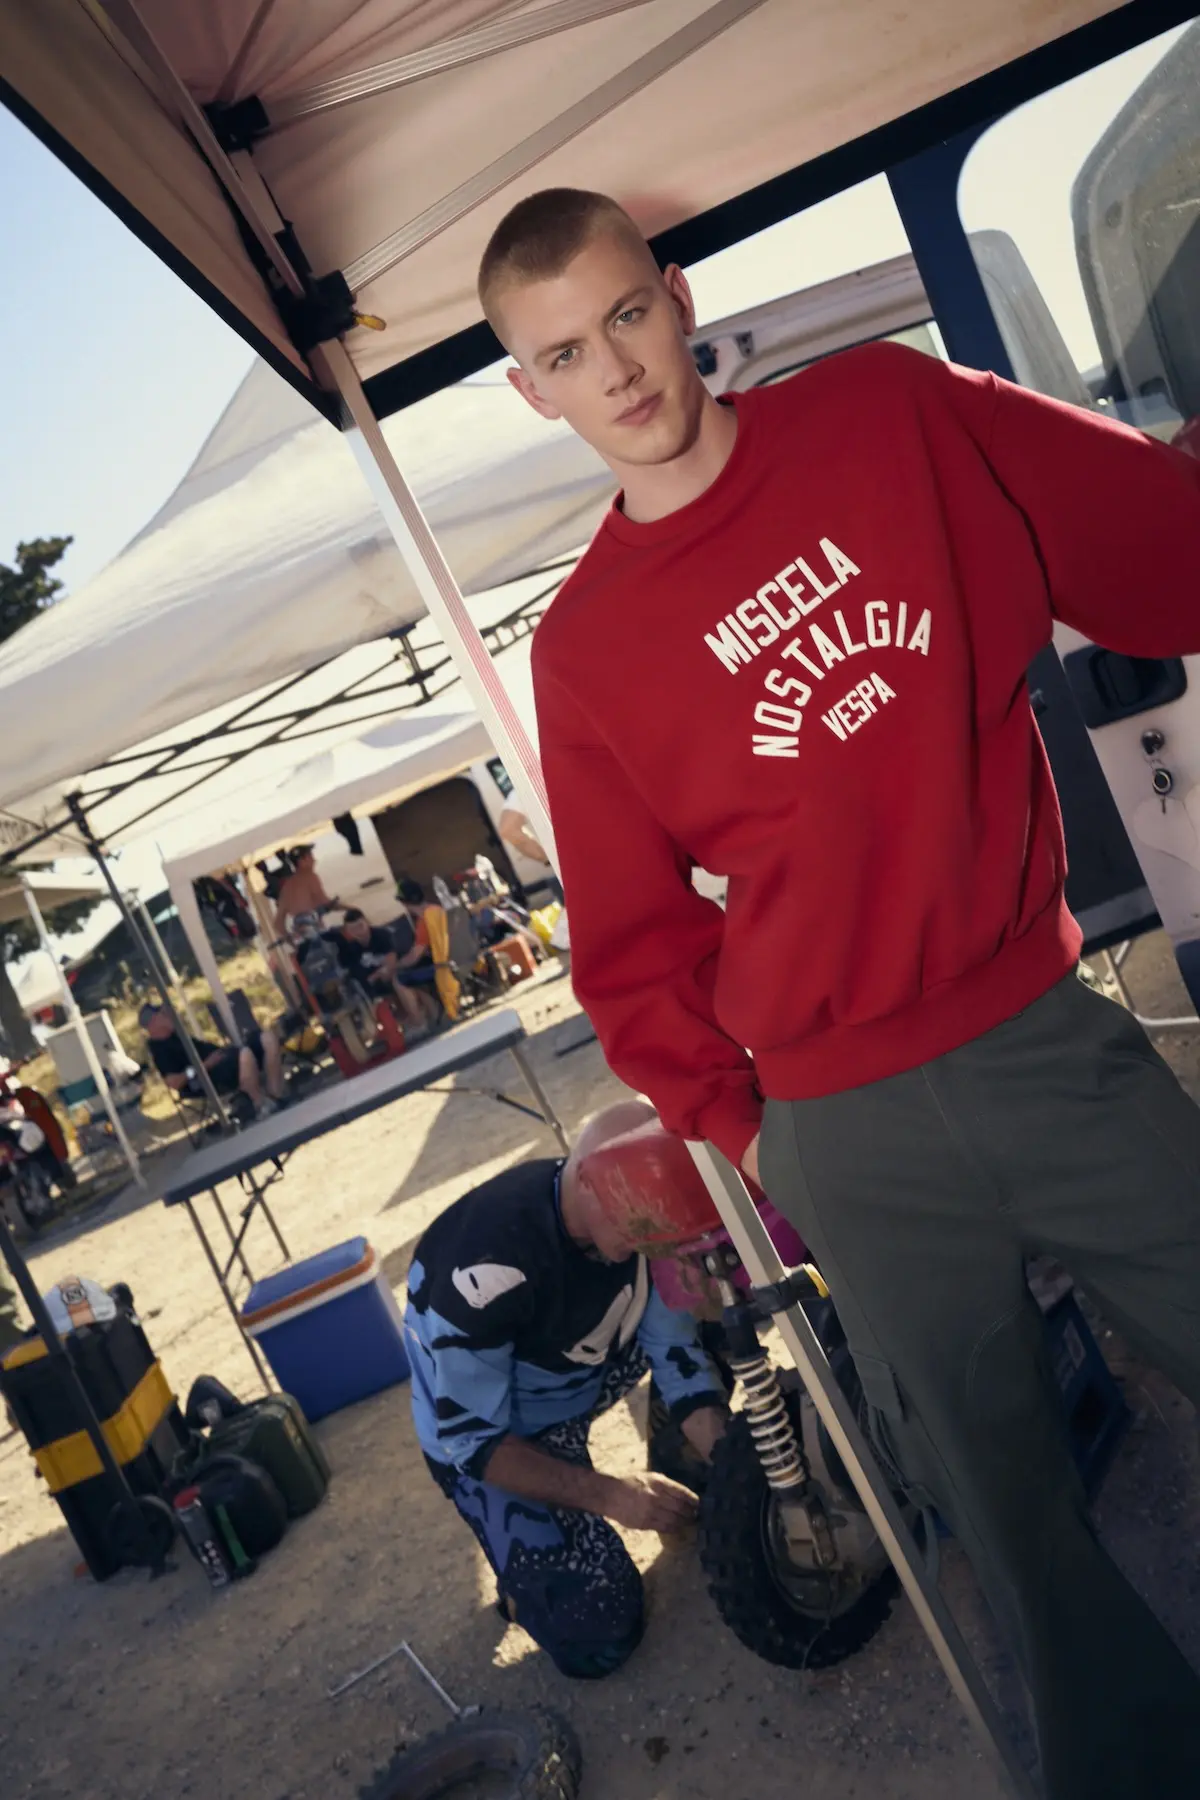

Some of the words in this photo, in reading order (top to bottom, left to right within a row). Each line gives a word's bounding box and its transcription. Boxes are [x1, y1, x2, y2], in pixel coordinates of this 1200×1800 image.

[704, 537, 861, 675] MISCELA
[752, 600, 932, 758] NOSTALGIA
[820, 671, 897, 742] VESPA
